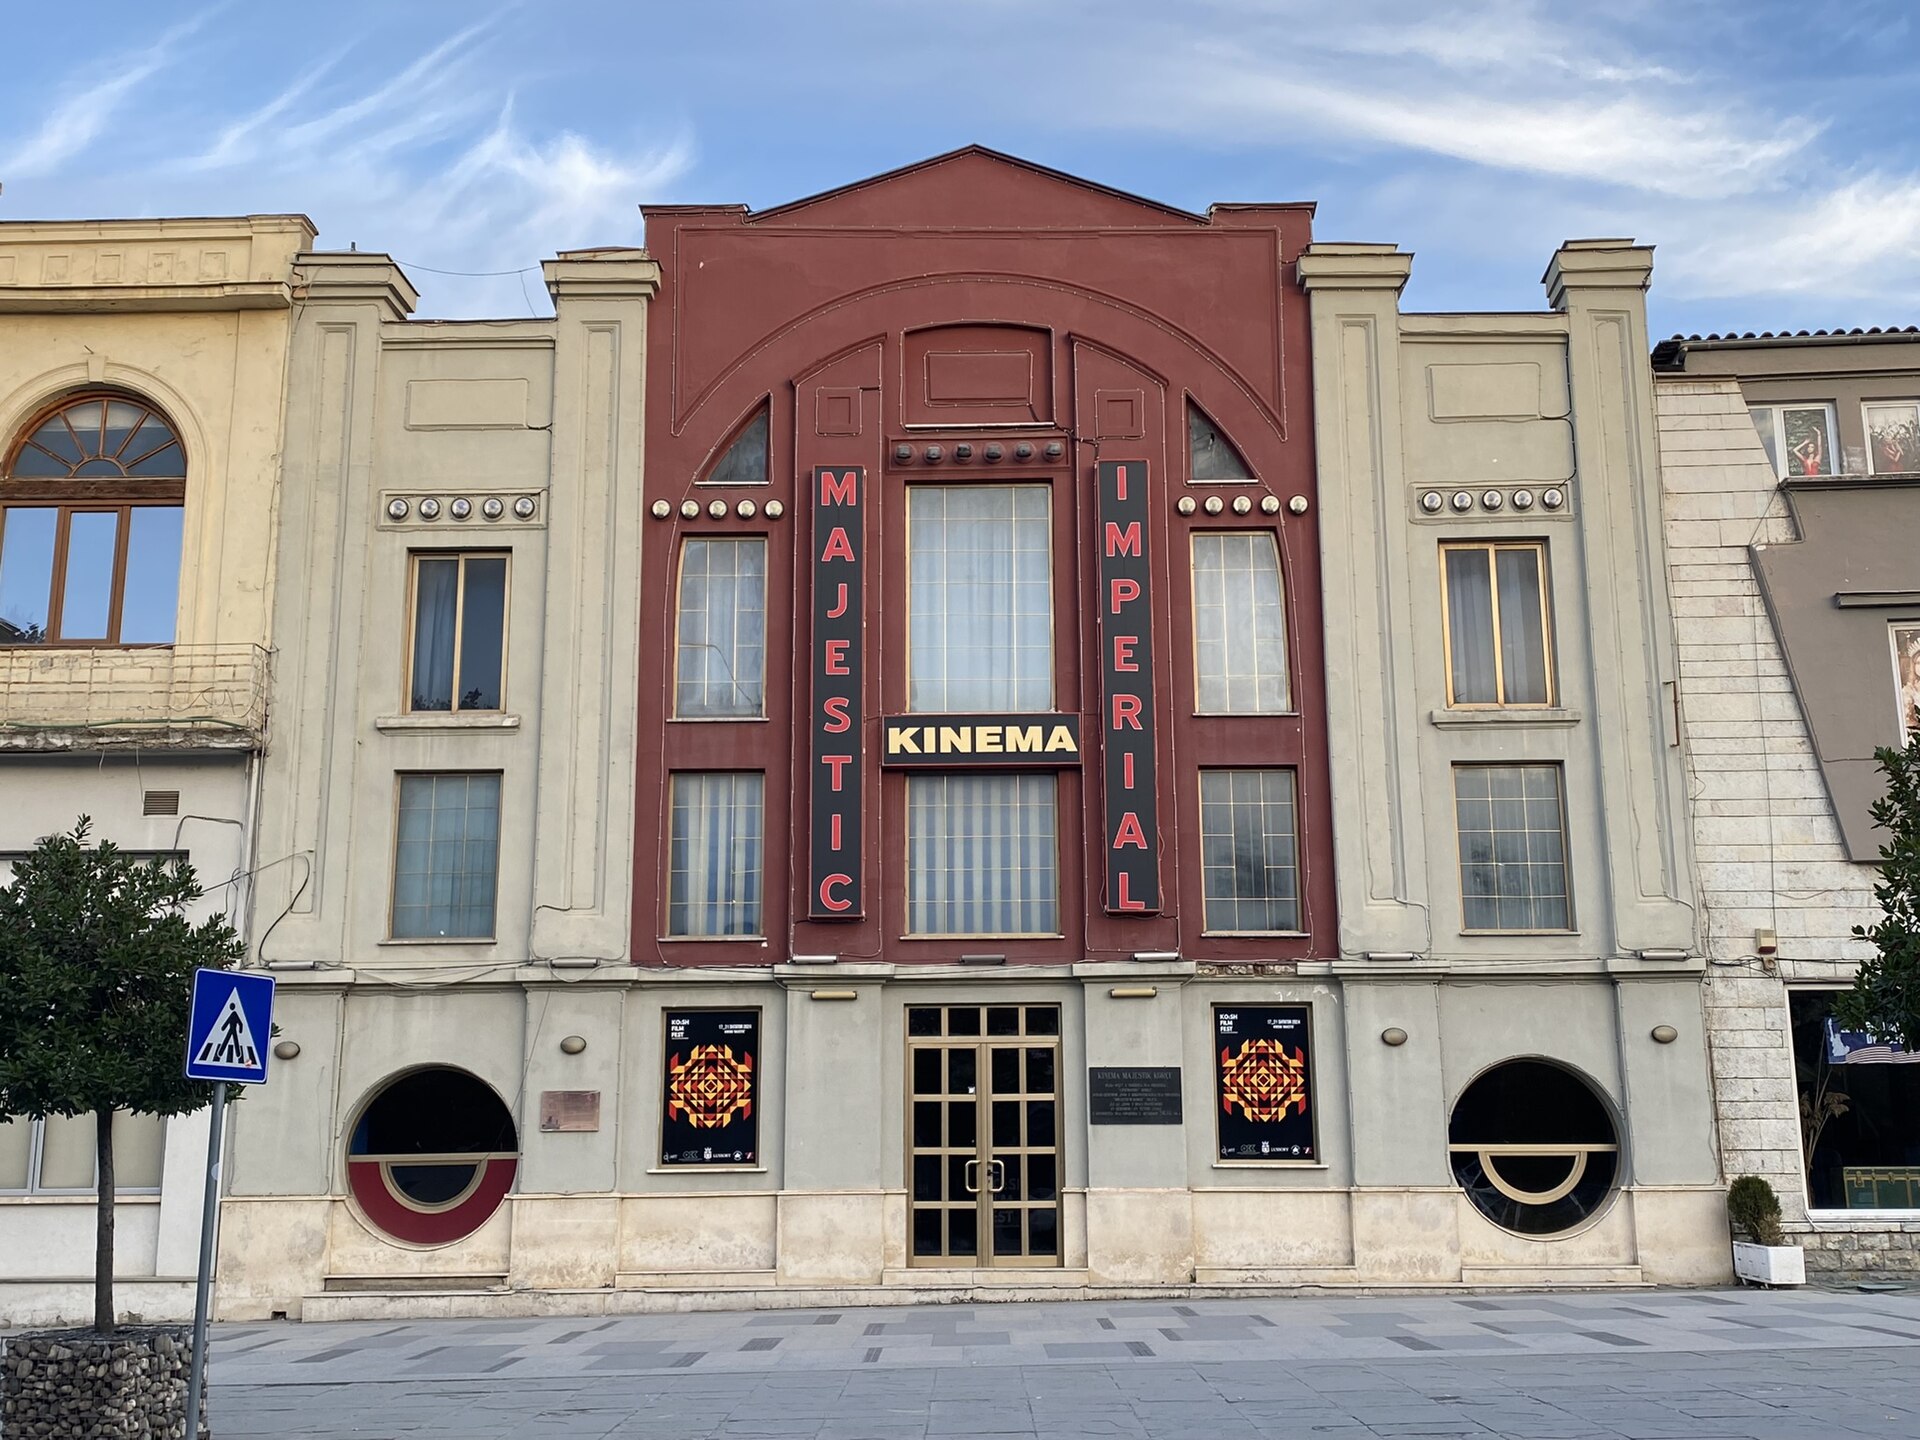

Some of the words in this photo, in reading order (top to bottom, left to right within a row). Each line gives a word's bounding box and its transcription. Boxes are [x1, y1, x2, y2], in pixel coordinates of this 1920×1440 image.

[819, 471, 857, 911] MAJESTIC
[887, 725, 1078, 754] KINEMA
[1105, 466, 1148, 910] IMPERIAL
